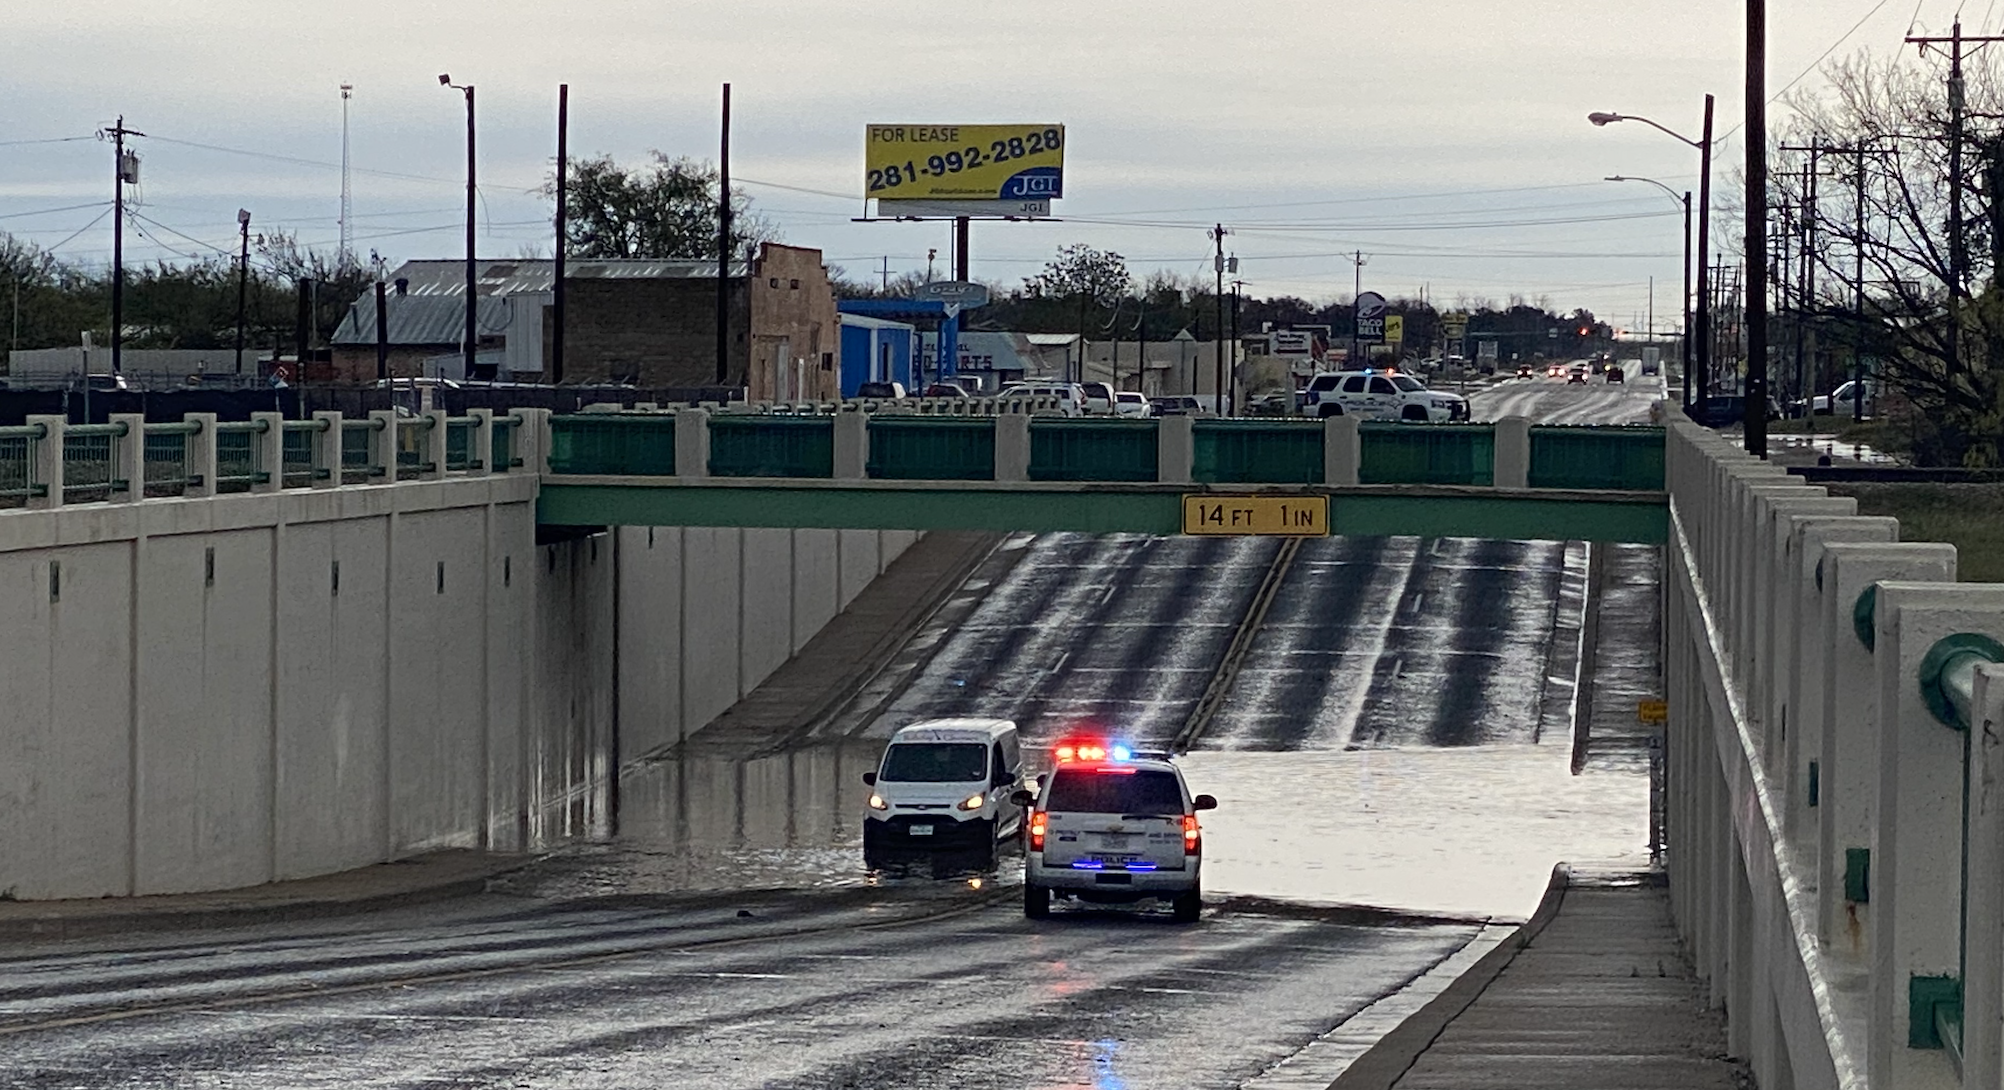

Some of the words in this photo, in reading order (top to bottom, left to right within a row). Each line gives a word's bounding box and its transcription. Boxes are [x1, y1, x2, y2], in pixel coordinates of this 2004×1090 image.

[872, 128, 905, 143] FOR
[910, 128, 959, 143] LEASE
[868, 128, 1061, 192] 281-992-2828
[1013, 175, 1056, 196] JGI
[1019, 203, 1044, 212] JGI
[1356, 318, 1383, 327] TACO
[1358, 326, 1383, 335] BELL
[1199, 504, 1224, 526] 14
[1232, 509, 1253, 526] FT
[1280, 504, 1288, 526] 1
[1294, 509, 1313, 526] IN
